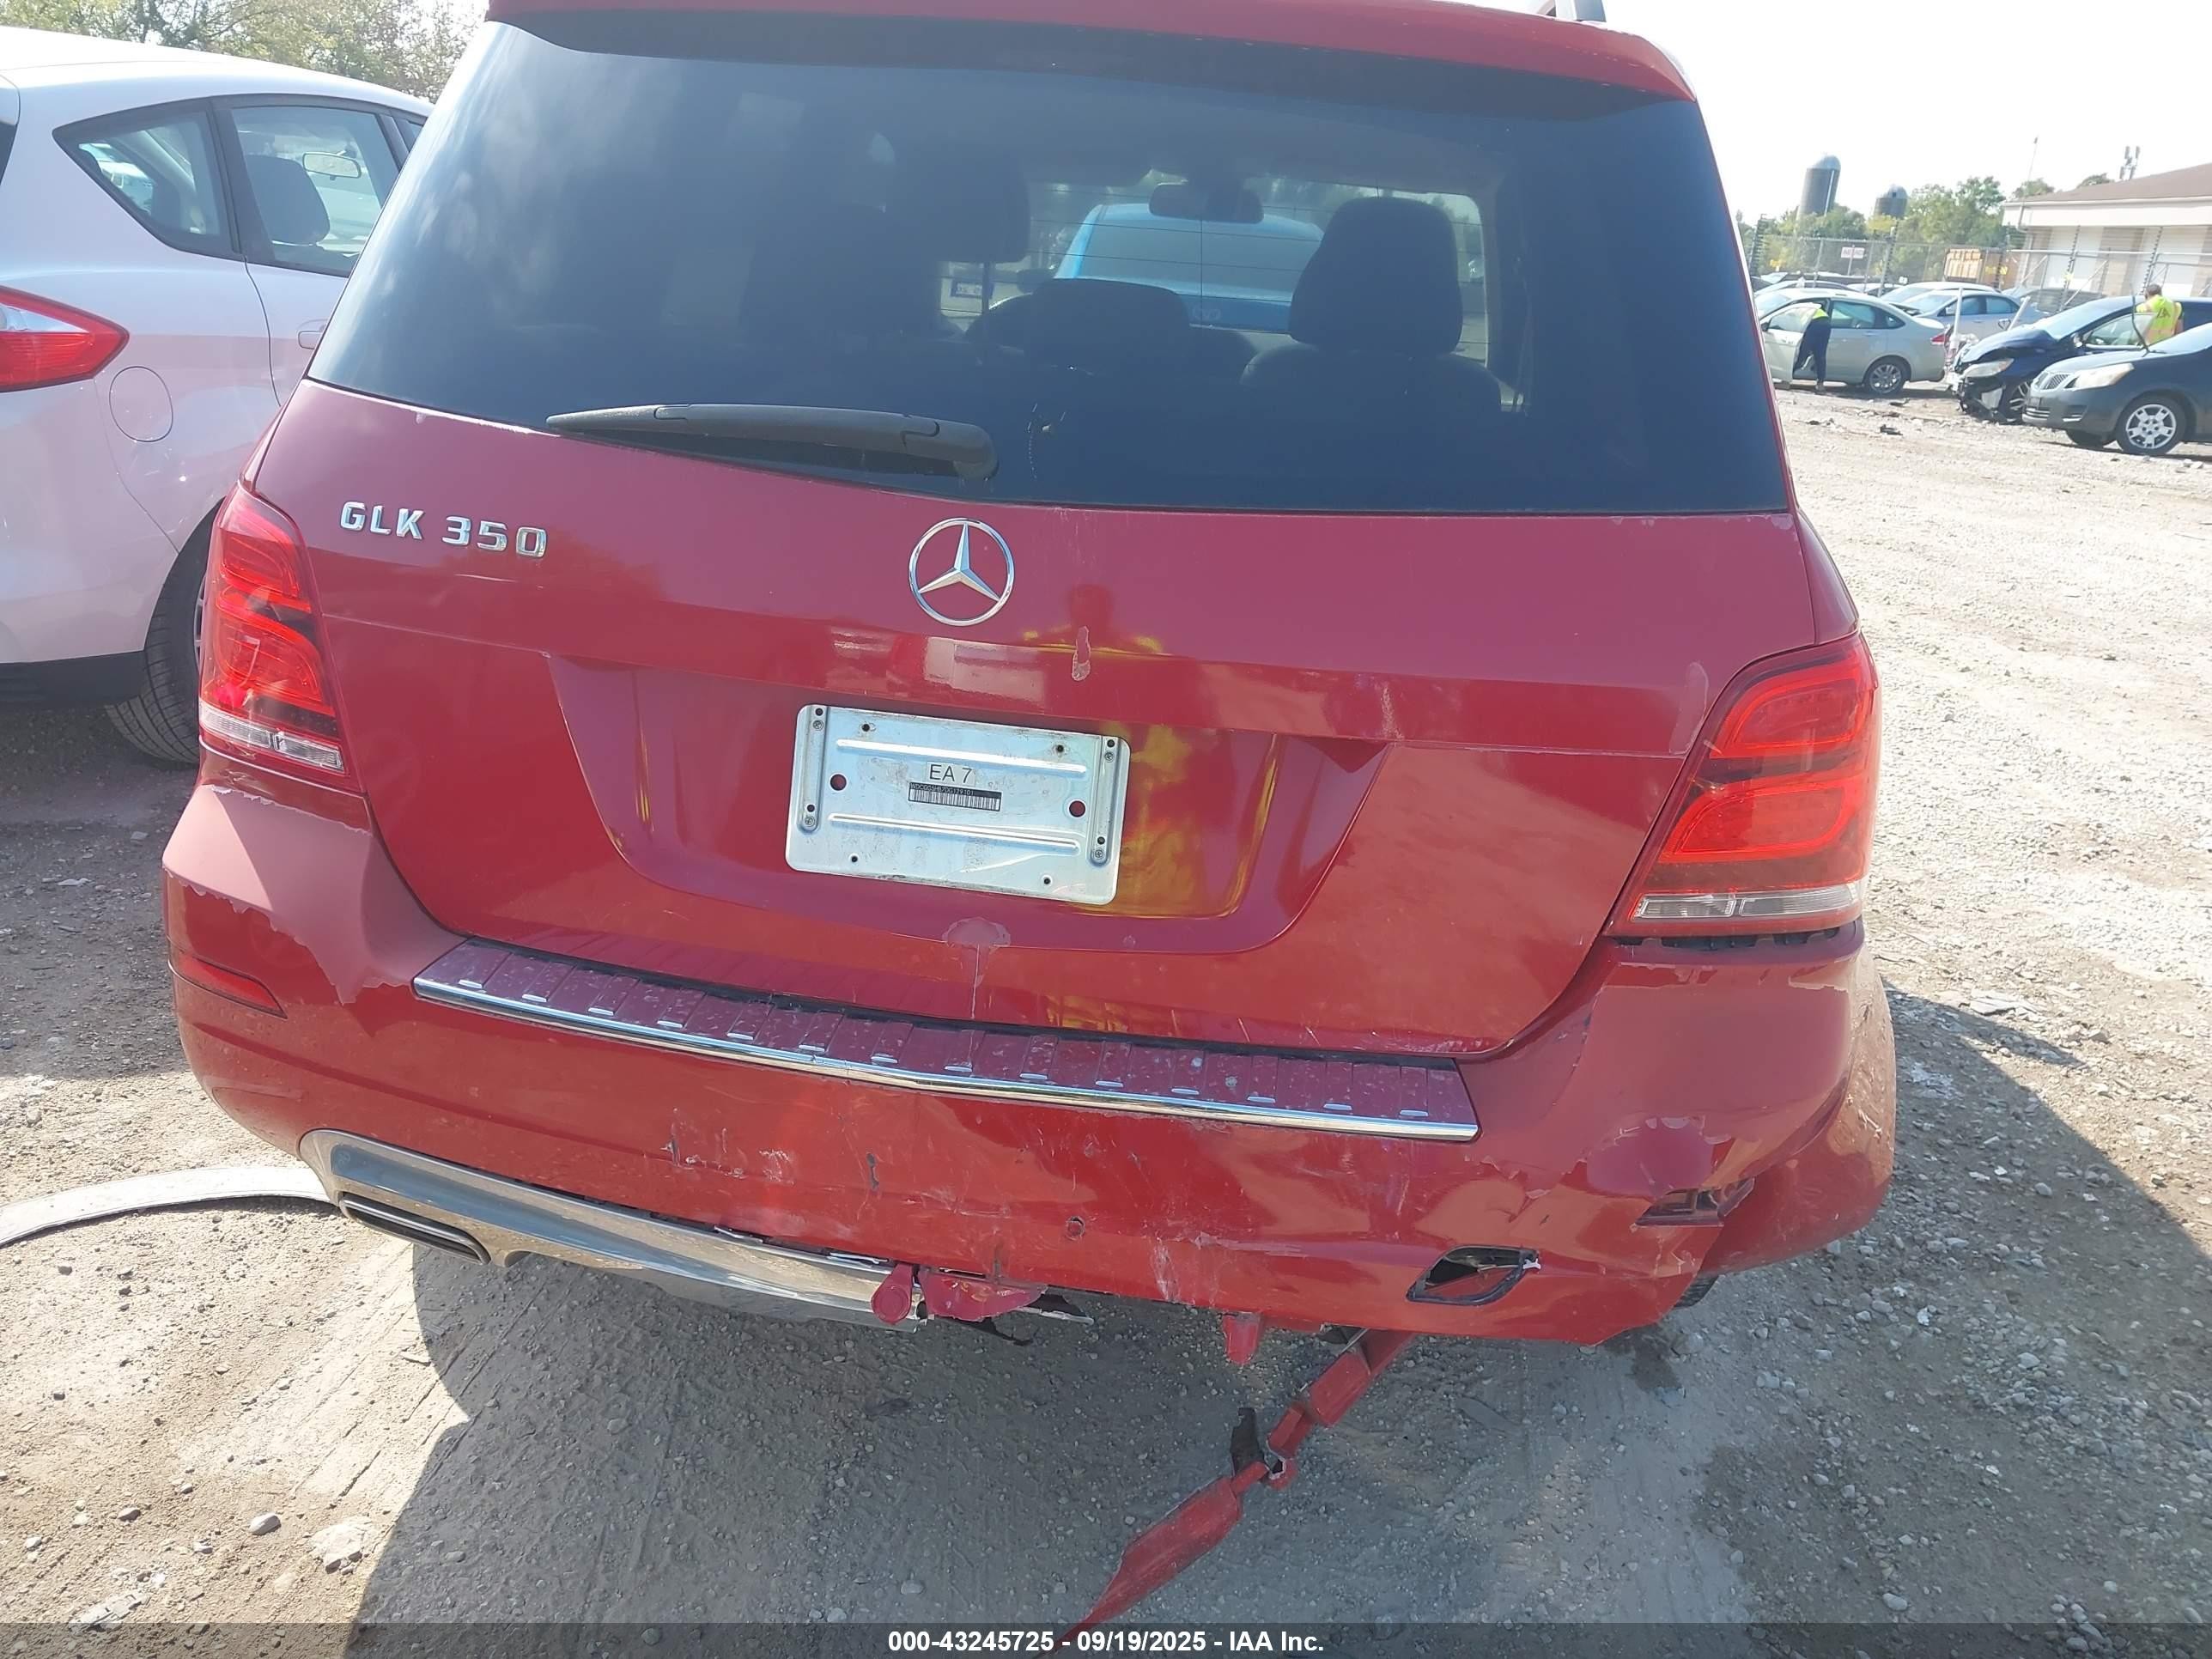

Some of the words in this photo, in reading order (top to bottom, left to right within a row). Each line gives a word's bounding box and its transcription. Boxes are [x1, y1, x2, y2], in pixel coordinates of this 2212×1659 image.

[340, 501, 425, 540] GLK
[441, 515, 547, 558] 350
[929, 763, 955, 782] EA
[962, 767, 973, 783] 7
